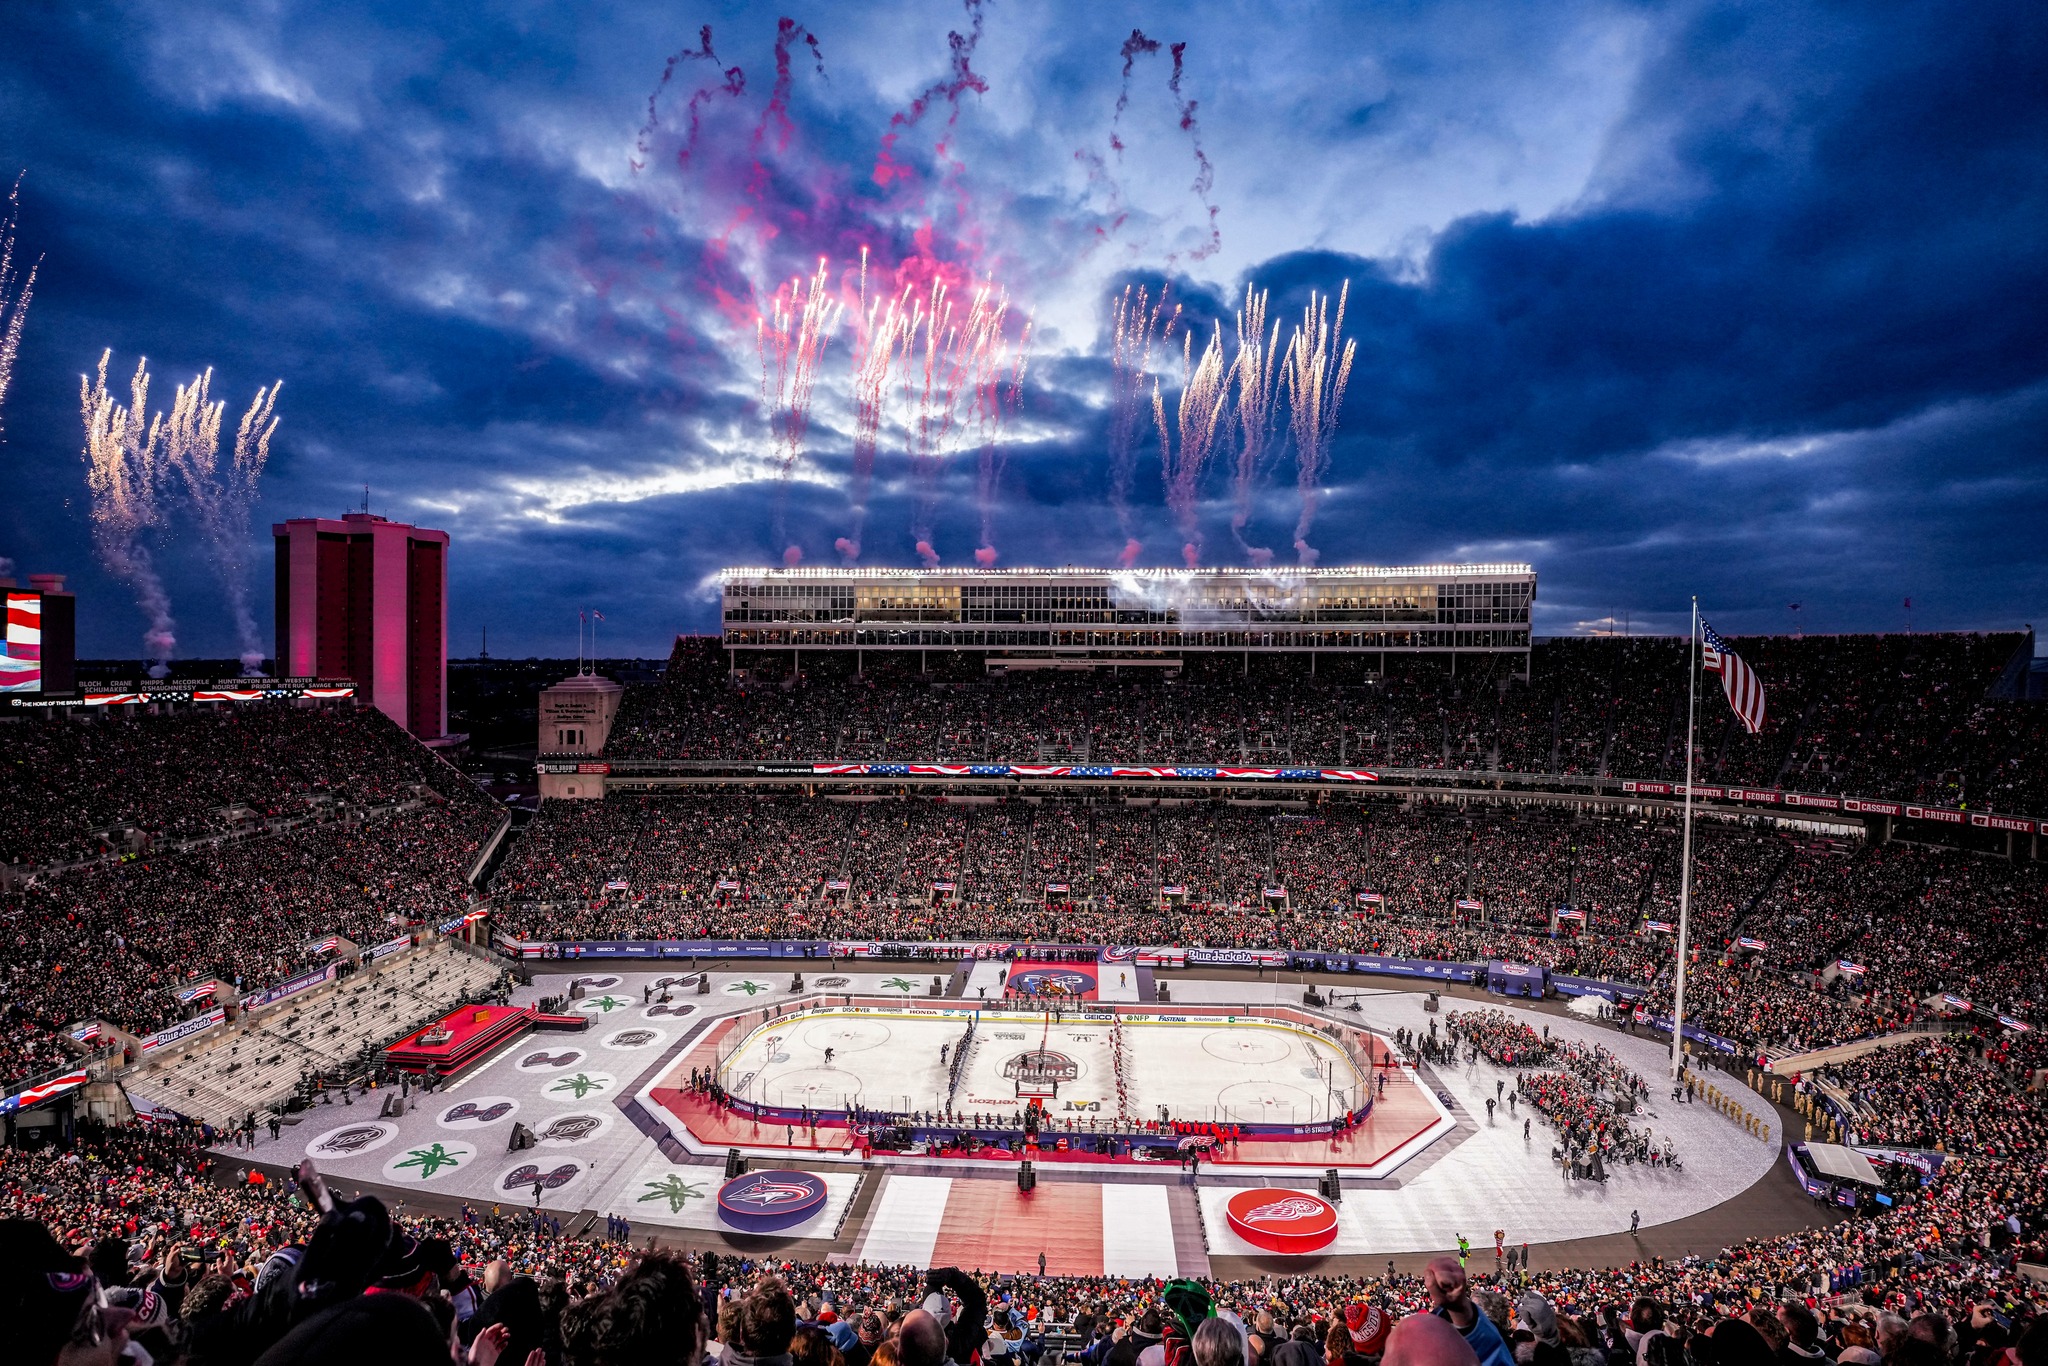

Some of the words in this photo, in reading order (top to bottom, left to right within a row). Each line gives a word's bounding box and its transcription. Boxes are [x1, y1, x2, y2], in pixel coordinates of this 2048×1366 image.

[1639, 785, 1664, 793] SMITH
[1690, 788, 1721, 797] HORVATH
[1746, 792, 1775, 802] GEORGE
[1800, 797, 1838, 808] JANOWICZ
[1861, 803, 1897, 815] CASSADY
[1924, 810, 1961, 822] GRIFFIN
[1991, 818, 2029, 831] HARLEY
[287, 979, 309, 994] STADIUM
[308, 973, 324, 985] SERIES
[1554, 981, 1579, 989] PRESIDIO
[765, 1015, 788, 1028] verizon
[1063, 1101, 1101, 1112] CAT
[1895, 1155, 1932, 1175] STADIUM
